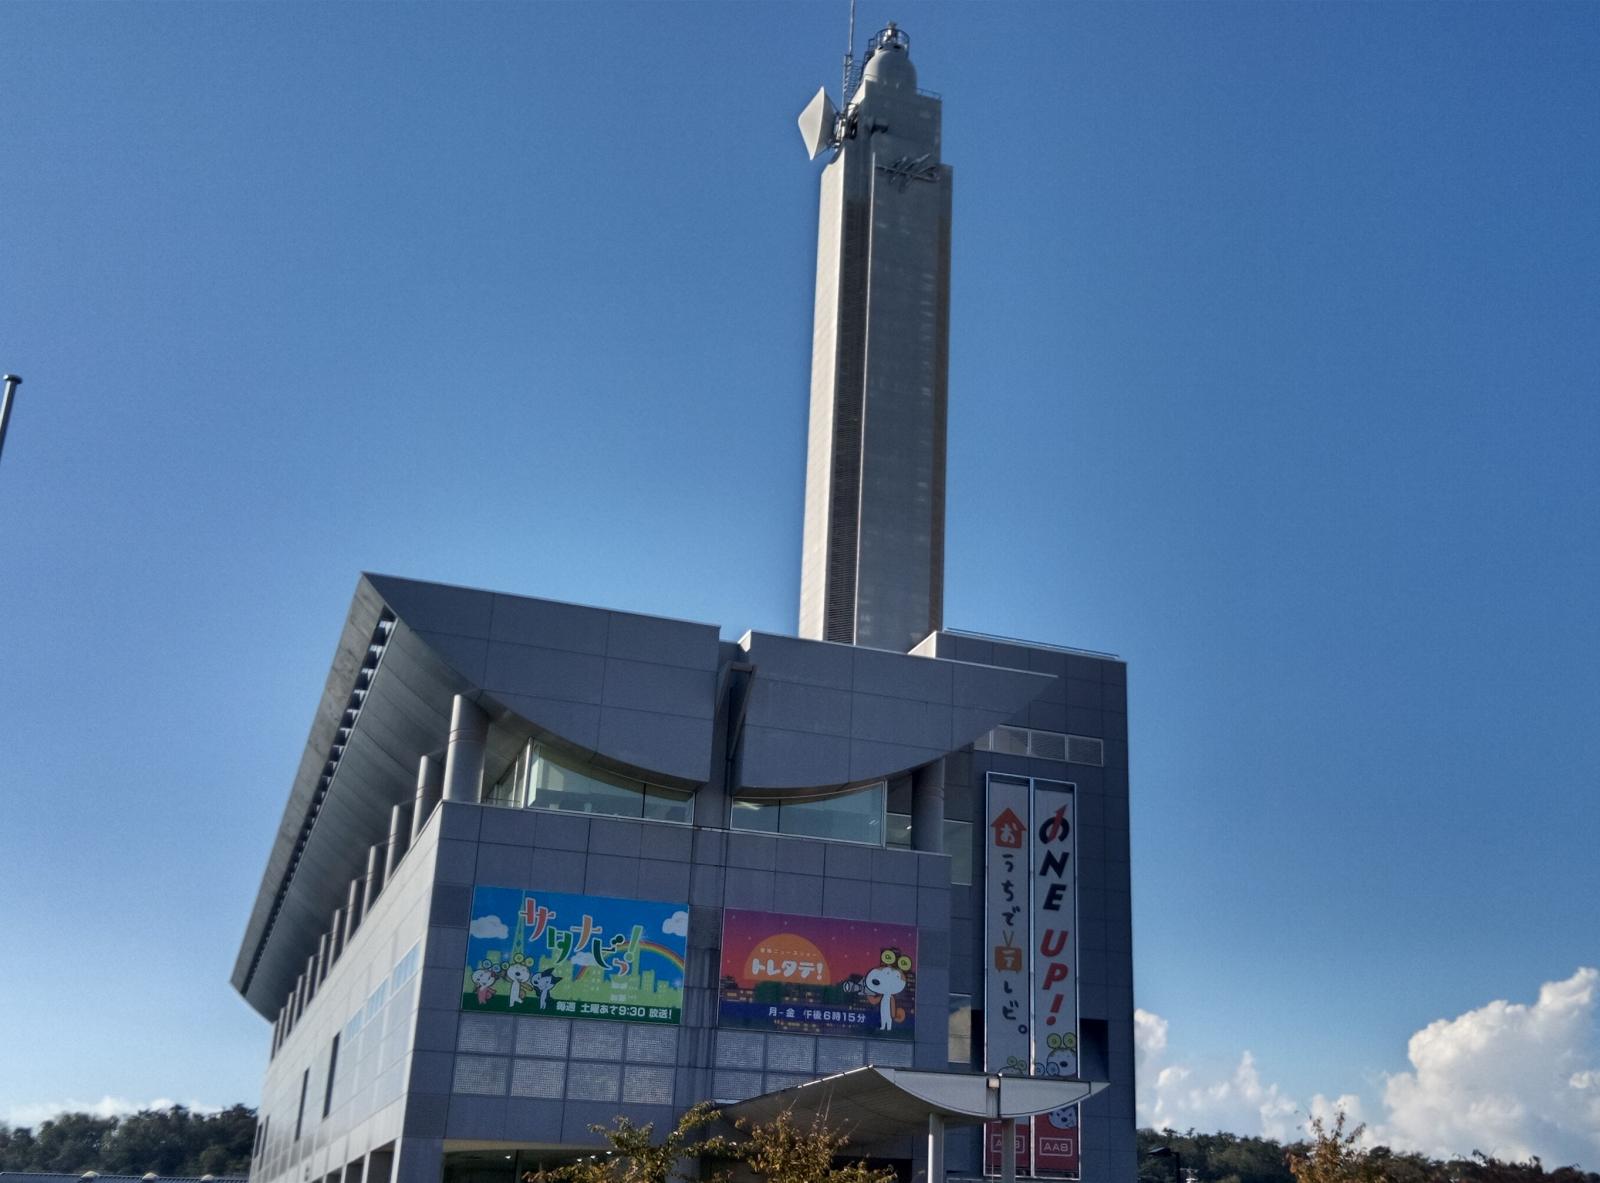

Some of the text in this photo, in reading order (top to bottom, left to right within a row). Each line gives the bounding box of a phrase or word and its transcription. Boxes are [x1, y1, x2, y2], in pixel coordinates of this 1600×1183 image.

[1038, 804, 1070, 1026] ONE UP!
[752, 958, 823, 981] トレタテ!
[556, 1001, 576, 1012] 毎週
[648, 1008, 672, 1019] 放送!
[1043, 1142, 1069, 1152] AAB
